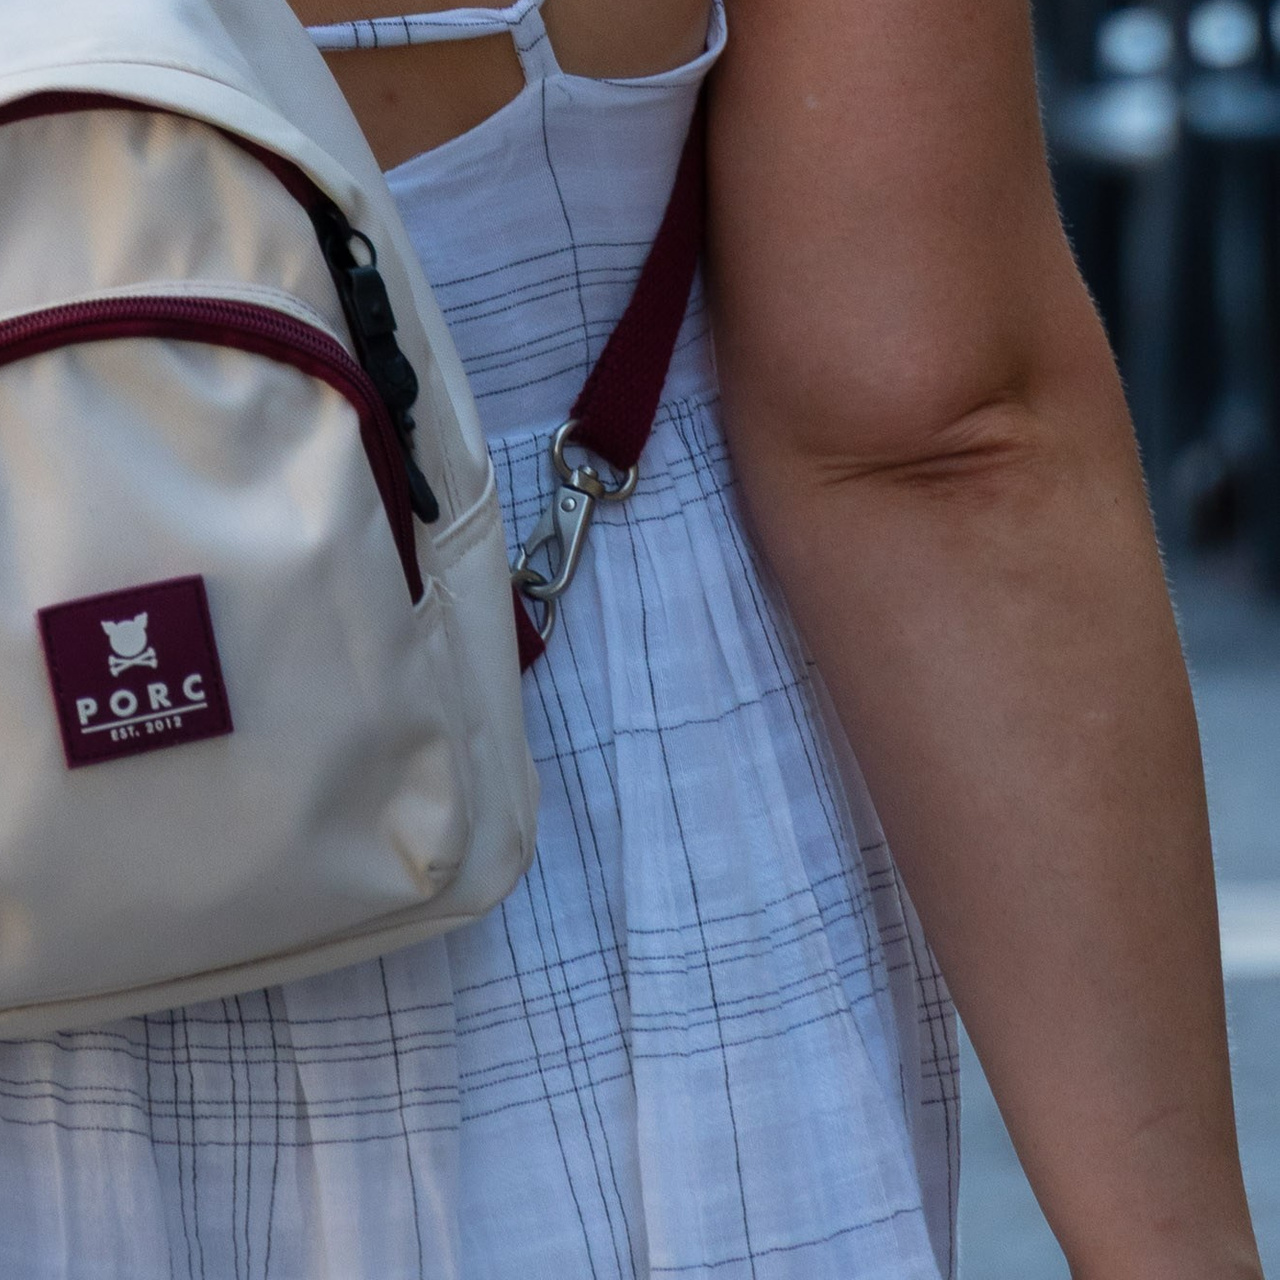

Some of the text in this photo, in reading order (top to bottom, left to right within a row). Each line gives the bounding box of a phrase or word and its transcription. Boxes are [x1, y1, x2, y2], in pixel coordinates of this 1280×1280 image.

[76, 674, 205, 725] PORC
[110, 716, 183, 741] EST. 2012
